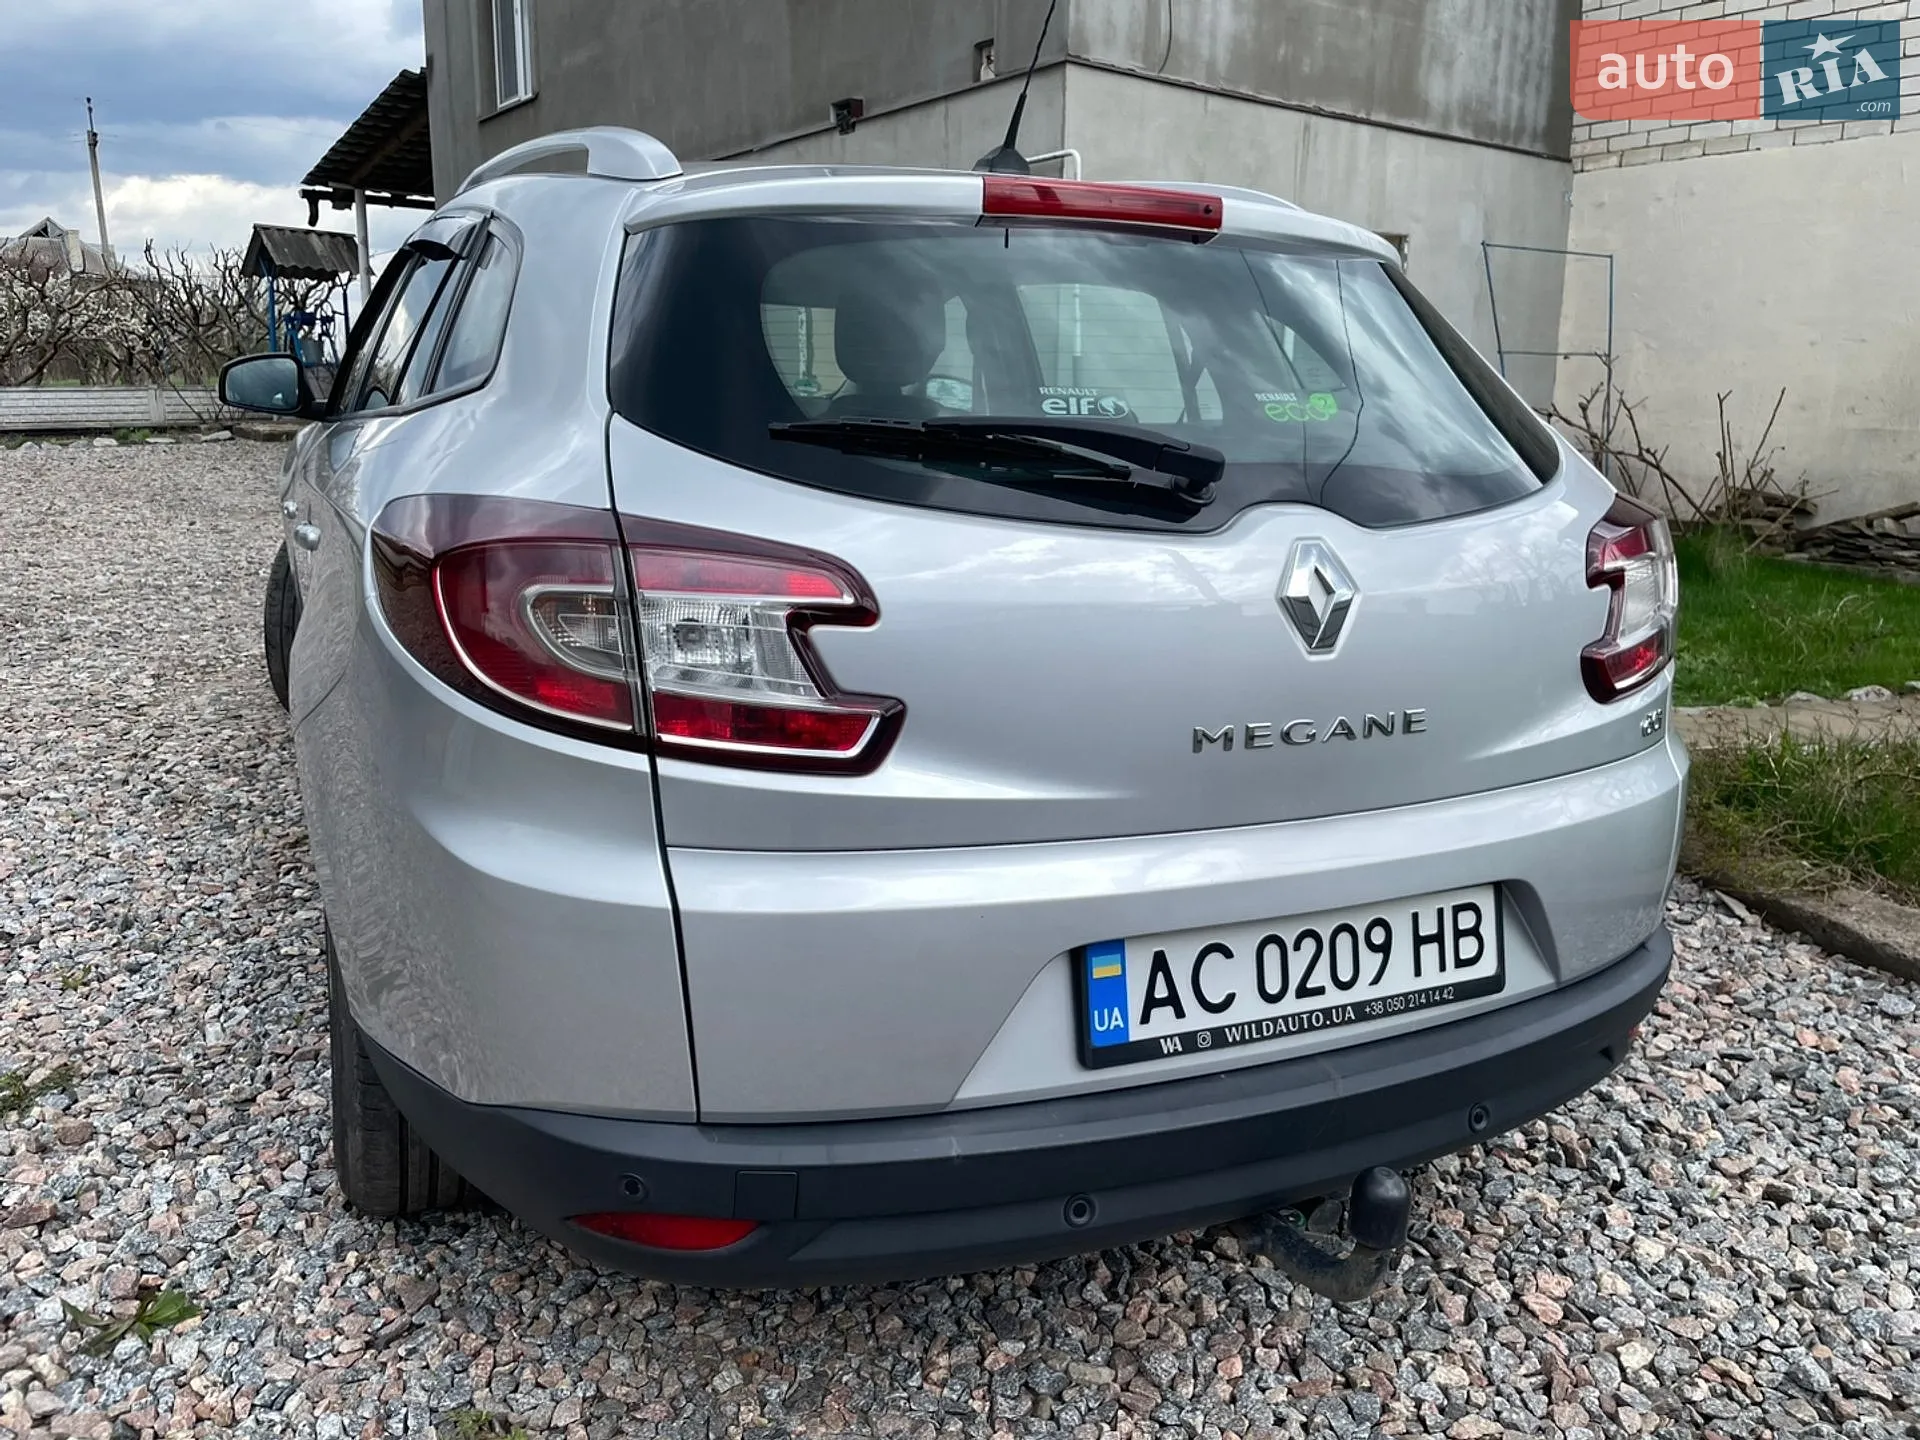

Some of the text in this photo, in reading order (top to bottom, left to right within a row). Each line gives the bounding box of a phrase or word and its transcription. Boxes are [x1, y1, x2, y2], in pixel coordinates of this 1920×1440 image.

[1039, 386, 1099, 398] RENAULT
[1192, 708, 1428, 753] MEGANE
[1139, 901, 1485, 1025] AC 0209 HB
[1094, 1007, 1125, 1032] UA
[1225, 1006, 1355, 1044] WILDAUTO.UA
[1365, 1001, 1384, 1016] +38
[1386, 997, 1405, 1012] 050
[1408, 993, 1426, 1008] 214
[1429, 990, 1440, 1003] 14
[1442, 986, 1455, 1000] 42
